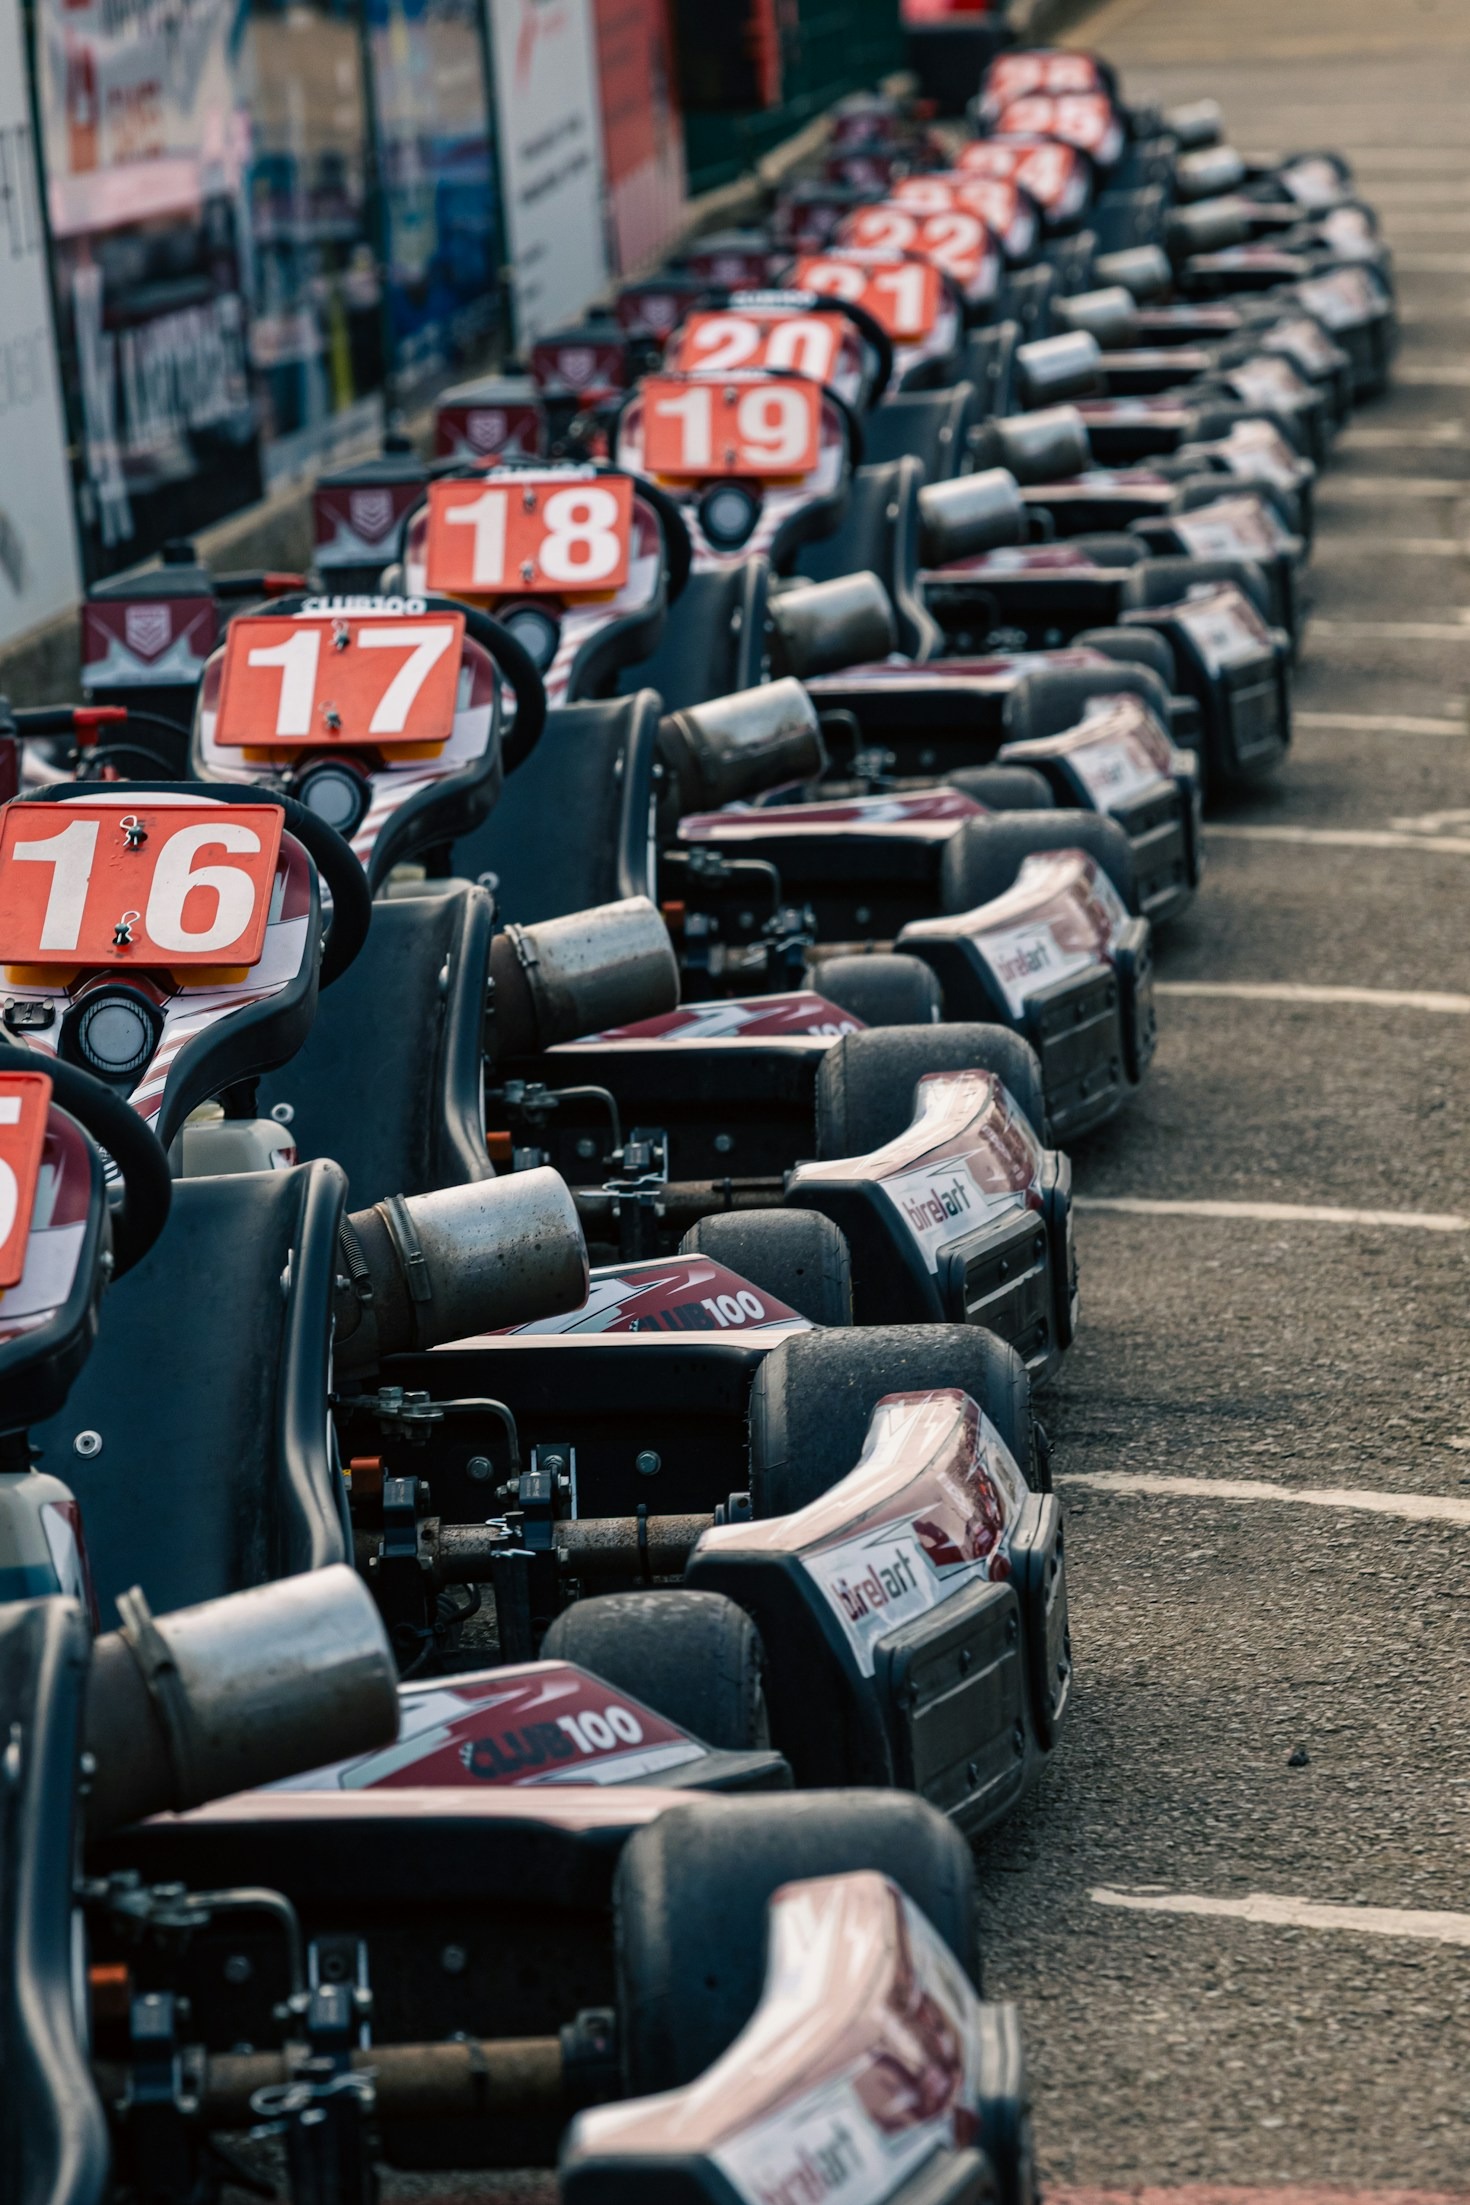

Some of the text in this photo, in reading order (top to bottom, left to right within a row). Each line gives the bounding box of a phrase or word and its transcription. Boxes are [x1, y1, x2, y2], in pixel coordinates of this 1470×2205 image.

[853, 207, 983, 278] 22
[804, 263, 924, 332] 21
[690, 319, 834, 382] 20
[656, 385, 809, 469] 19
[445, 487, 621, 585] 18
[247, 625, 454, 736] 17
[12, 820, 261, 952] 16
[459, 1705, 644, 1779] CLUB100
